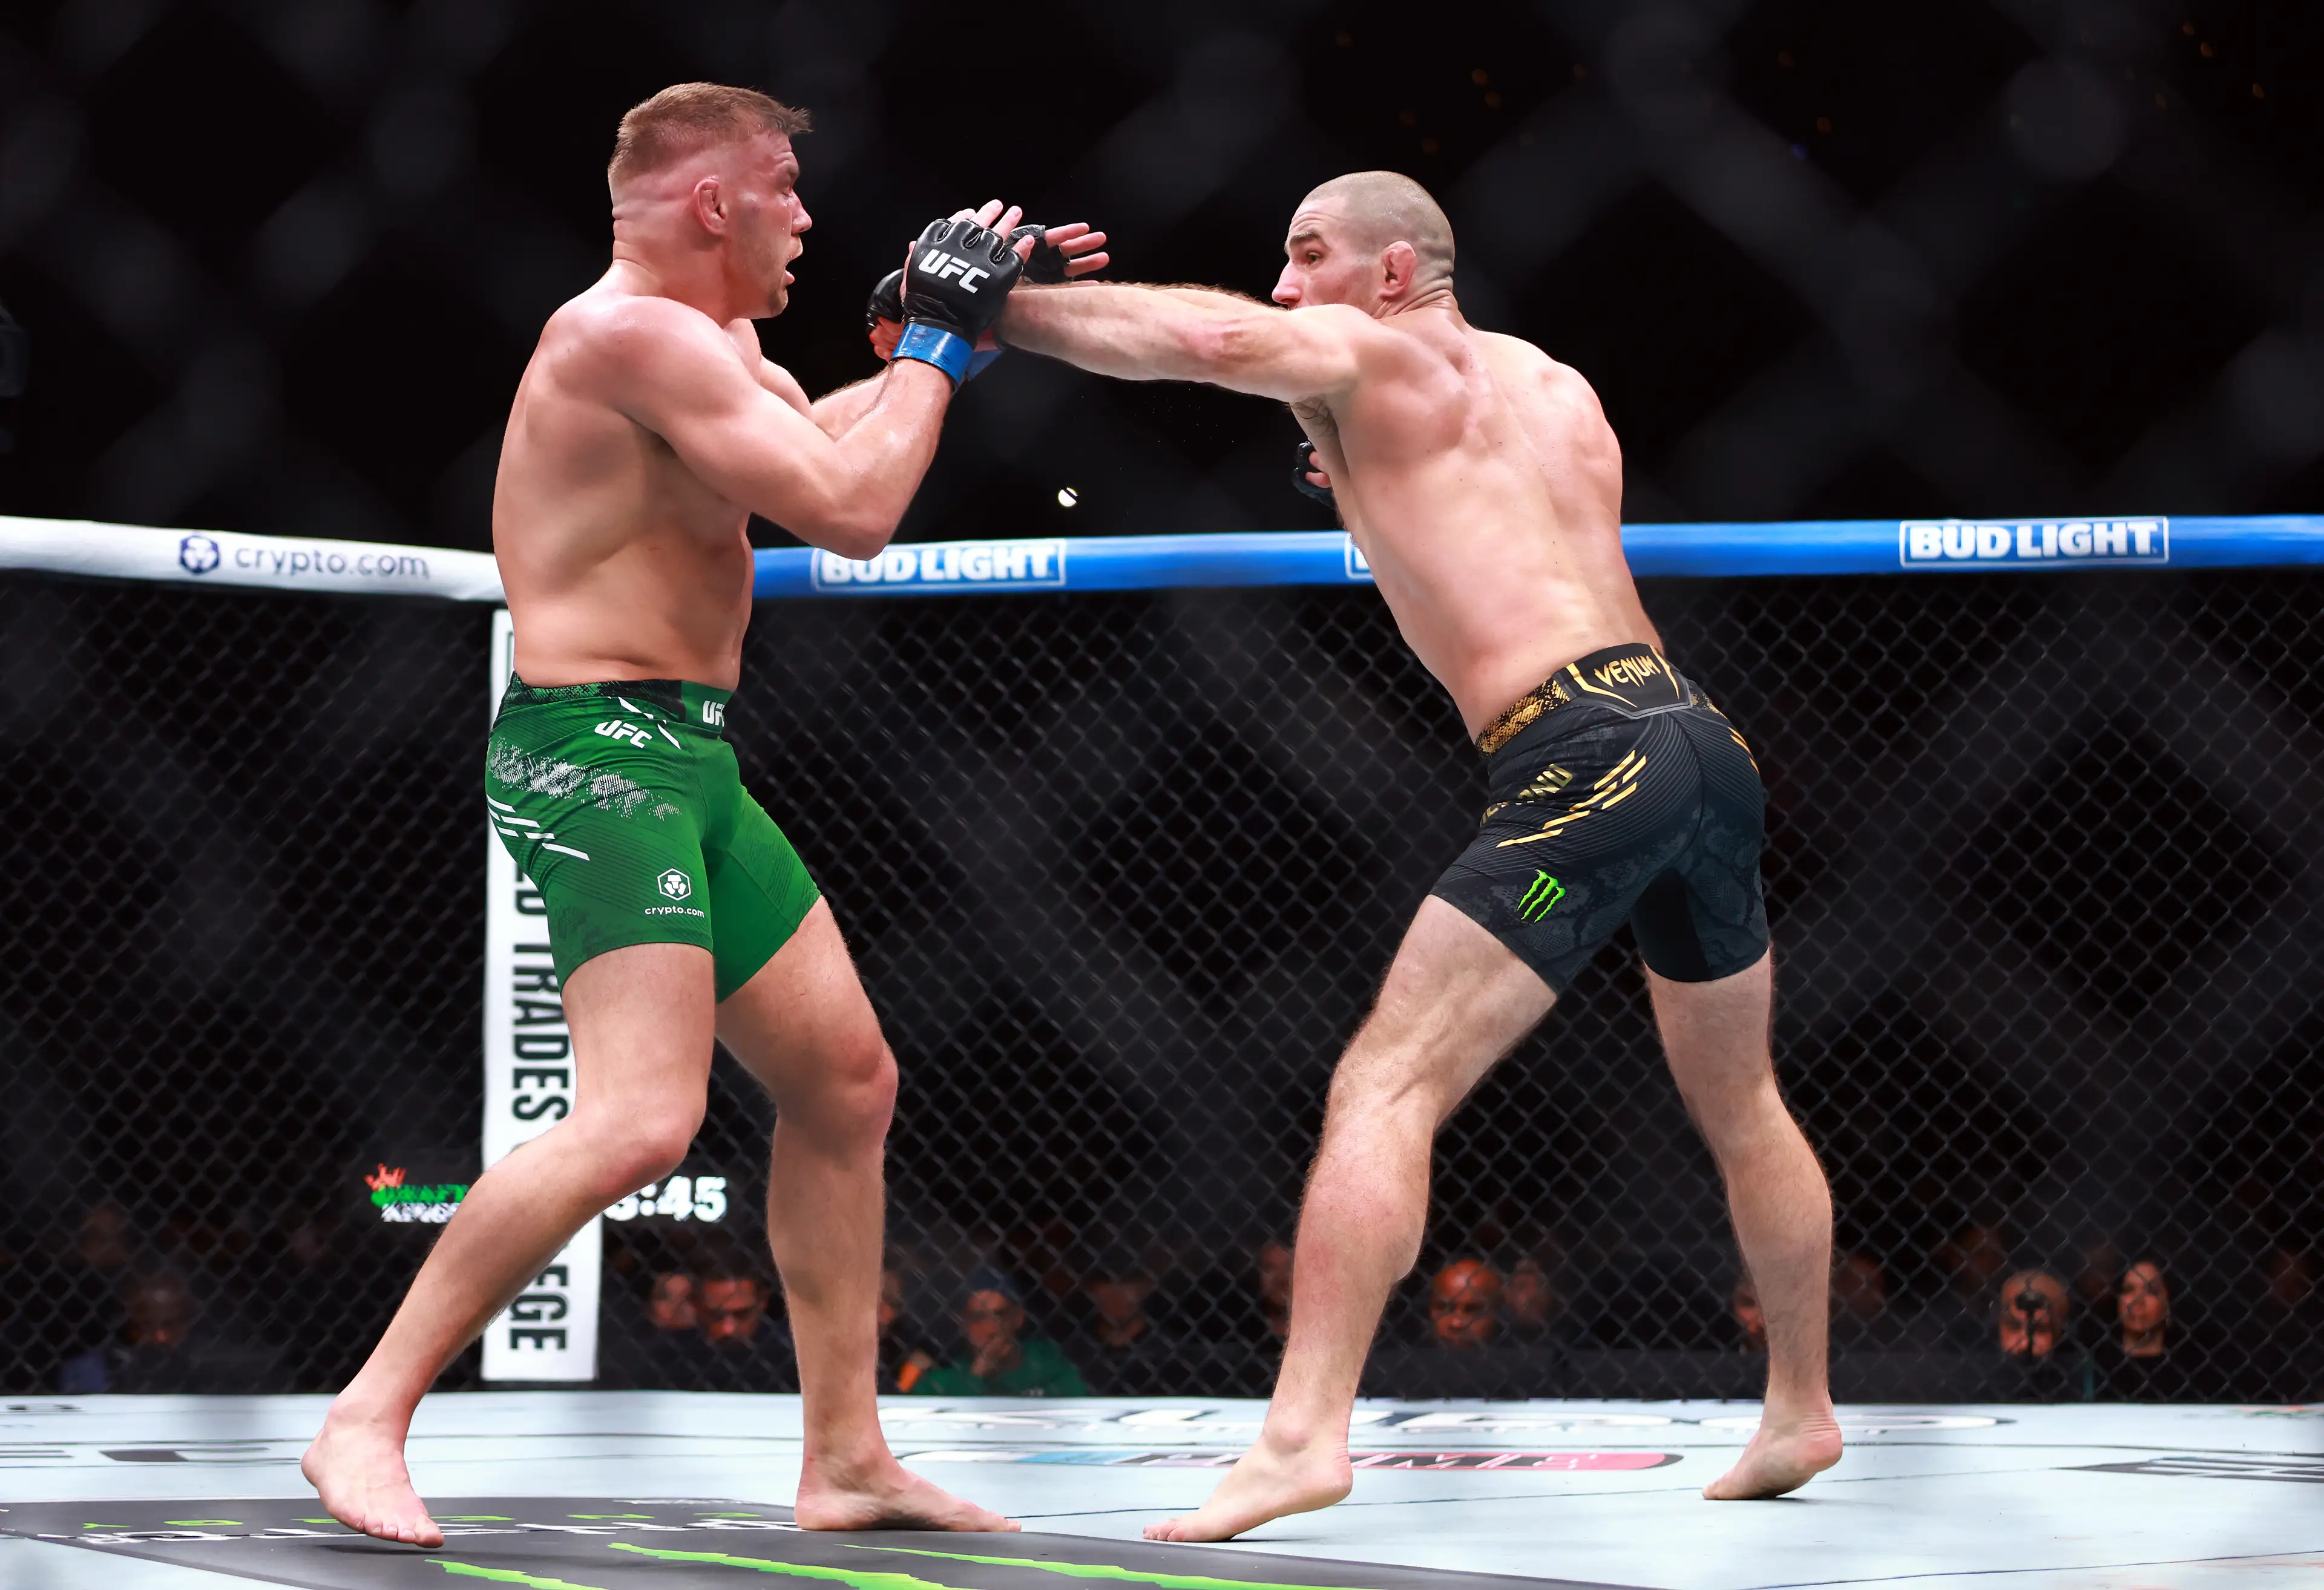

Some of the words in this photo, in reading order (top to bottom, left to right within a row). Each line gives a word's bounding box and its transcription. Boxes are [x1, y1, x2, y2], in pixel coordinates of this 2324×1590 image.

[917, 249, 991, 294] UFC
[1909, 526, 2012, 560] BUD
[2016, 521, 2159, 558] LIGHT
[235, 548, 429, 578] crypto.com
[821, 548, 917, 584] BUD
[920, 545, 1057, 581] LIGHT
[1594, 655, 1661, 688] VENUM
[703, 700, 725, 727] UF
[594, 719, 652, 748] UFC
[645, 905, 704, 918] crypto.com
